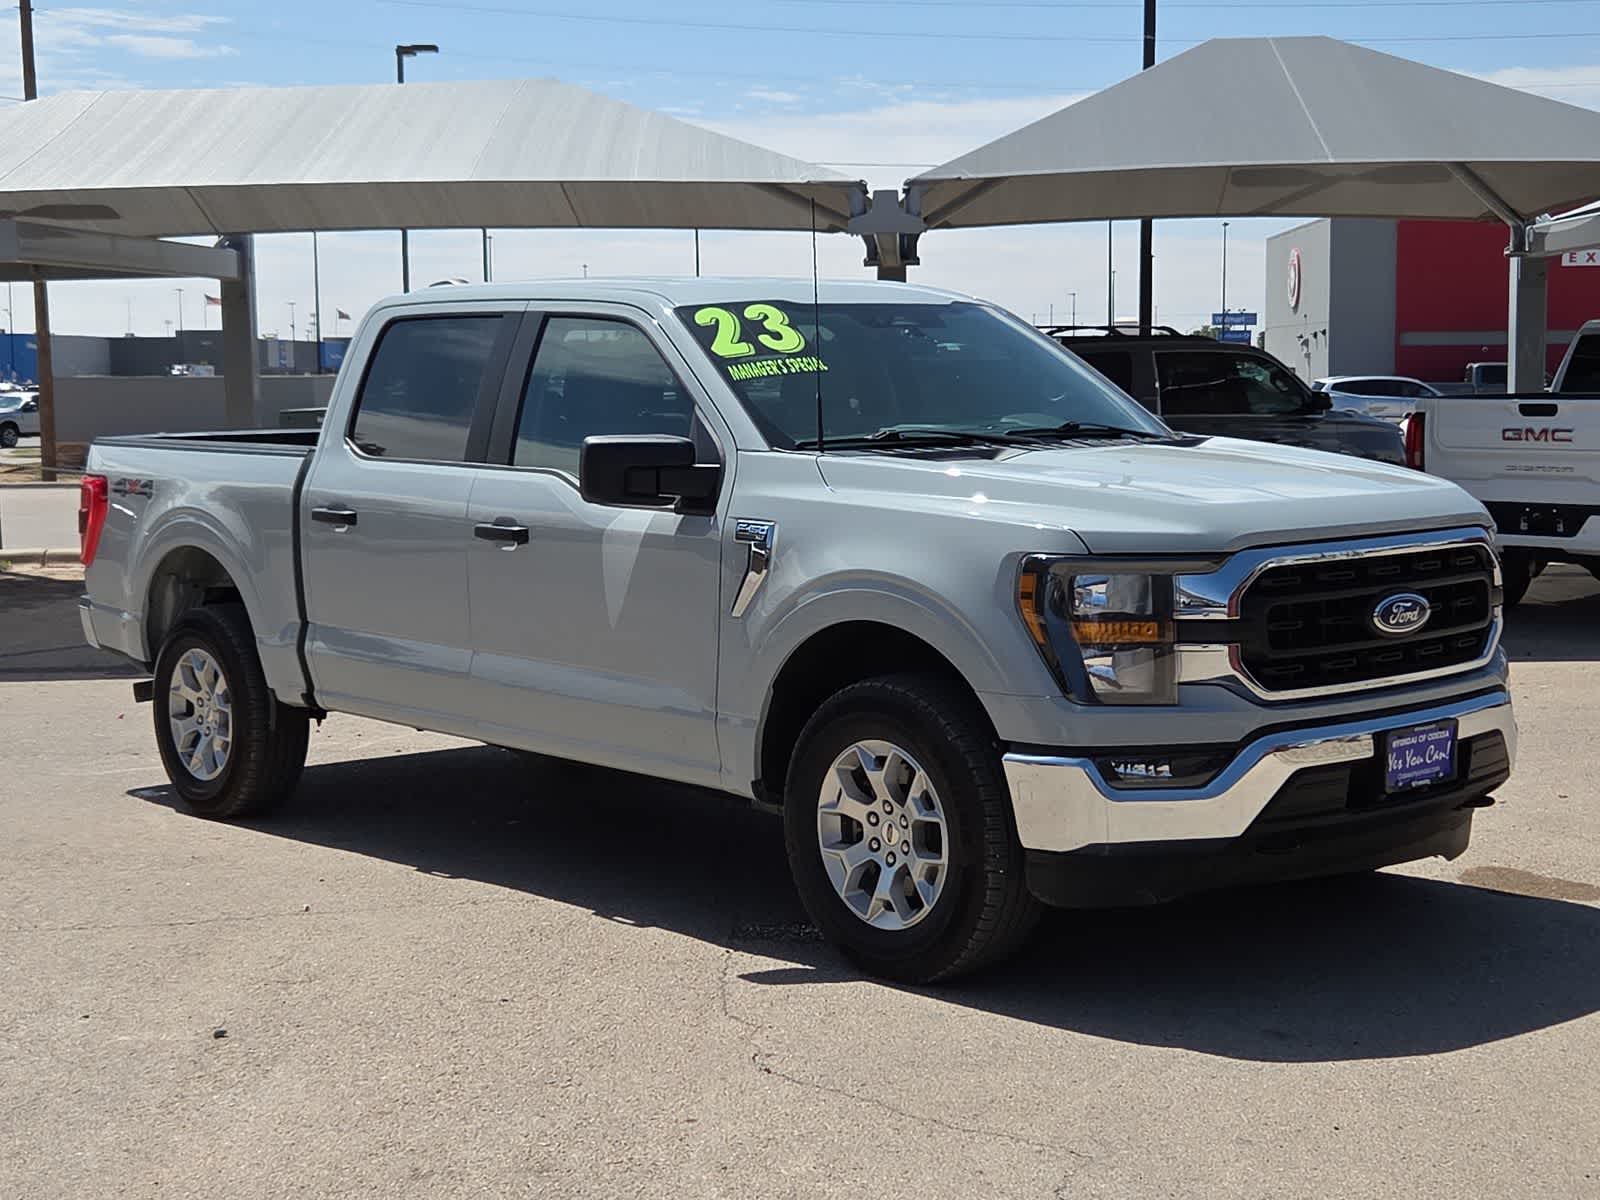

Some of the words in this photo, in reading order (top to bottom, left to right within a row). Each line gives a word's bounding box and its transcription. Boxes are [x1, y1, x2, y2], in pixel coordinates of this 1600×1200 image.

[694, 304, 806, 358] 23
[727, 359, 788, 381] MANAGER'S
[785, 356, 829, 373] SPECIAL
[1502, 428, 1575, 442] GMC
[1389, 602, 1420, 624] Ford
[1388, 752, 1403, 772] Yes
[1405, 749, 1424, 768] You
[1425, 740, 1451, 763] Can!
